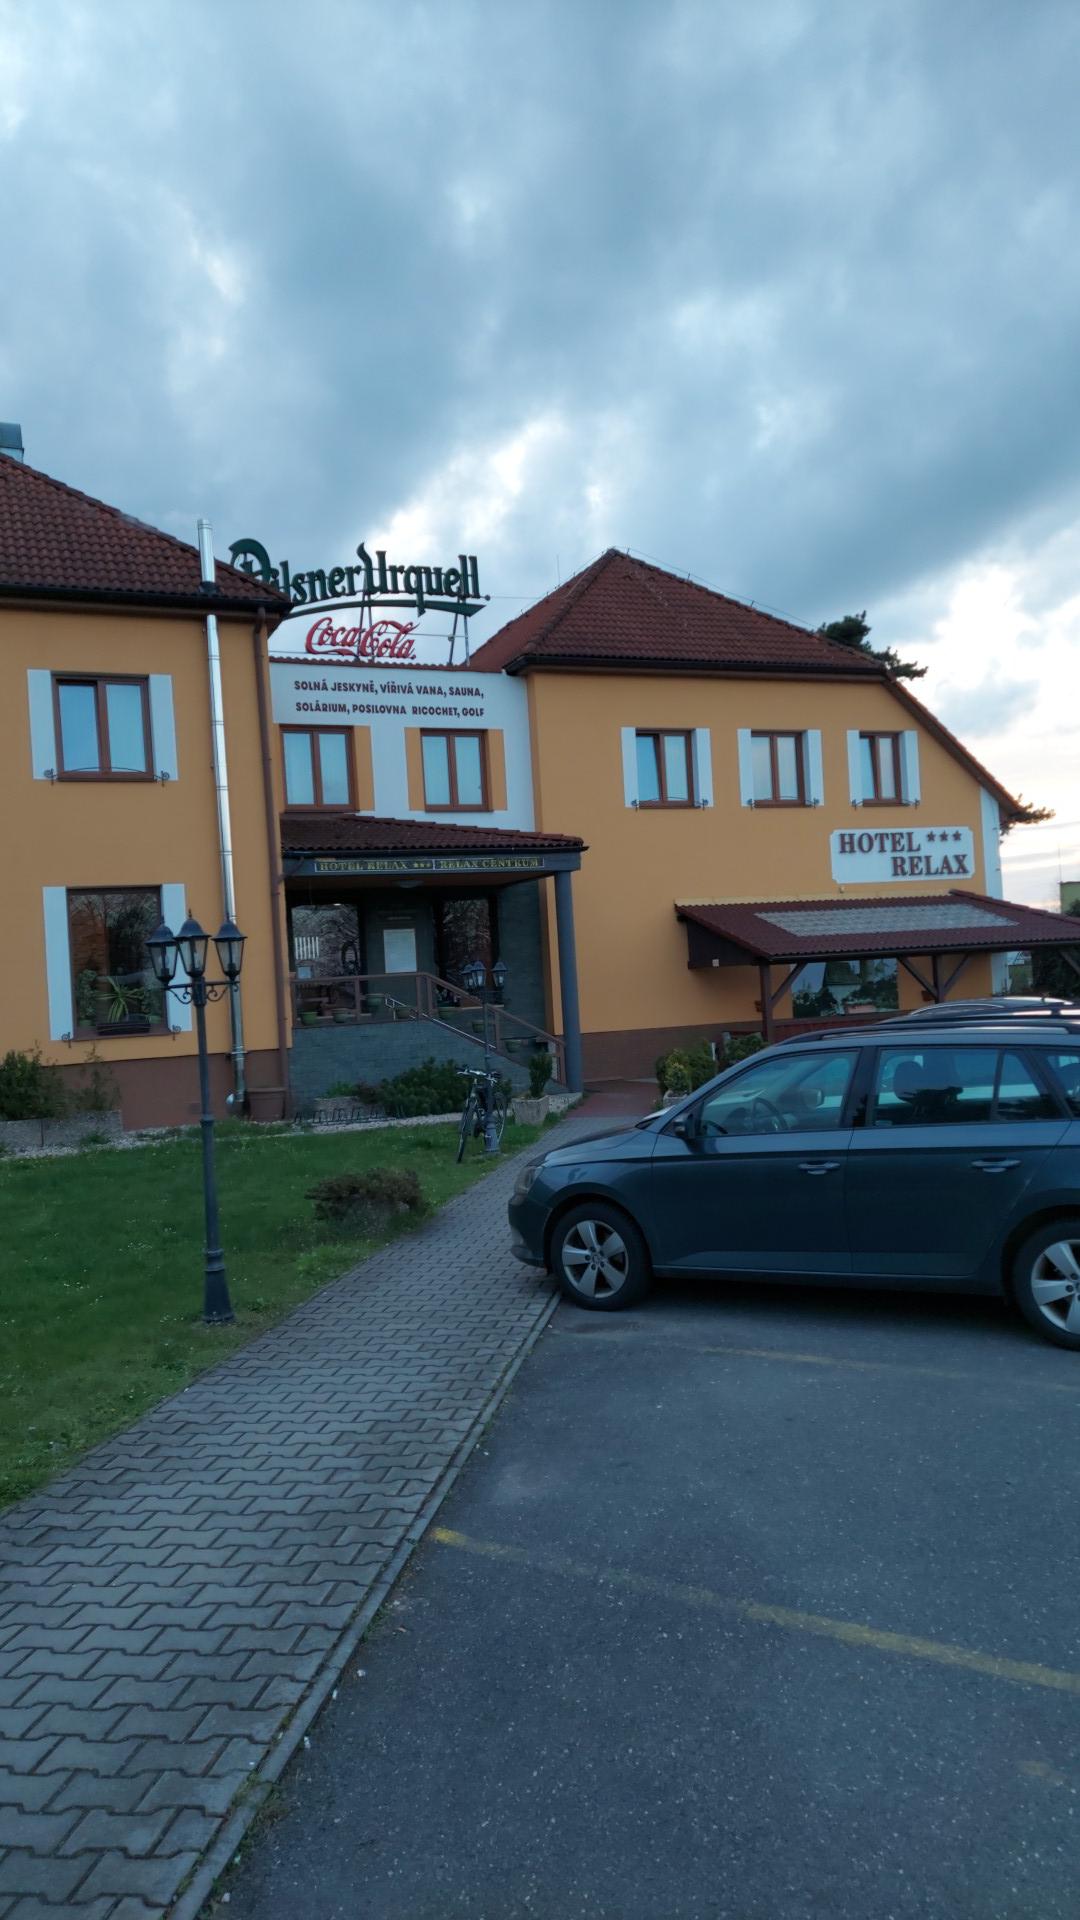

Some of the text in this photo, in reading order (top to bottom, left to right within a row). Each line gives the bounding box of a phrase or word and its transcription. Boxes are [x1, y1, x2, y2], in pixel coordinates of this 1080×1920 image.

[228, 538, 482, 617] Pilsner Urquell
[294, 679, 328, 691] SOLNÁ
[379, 681, 414, 694] VÍŘIVÁ
[416, 685, 447, 698] VANA,
[448, 686, 484, 699] SAUNA,
[295, 700, 484, 718] SOLÁRIUM, POSILOVNA RICOCHET, GOLF
[839, 832, 921, 854] HOTEL
[320, 860, 408, 871] HOTEL RELAX
[440, 857, 538, 869] RELAX CENTRUM
[891, 854, 969, 876] RELAX
